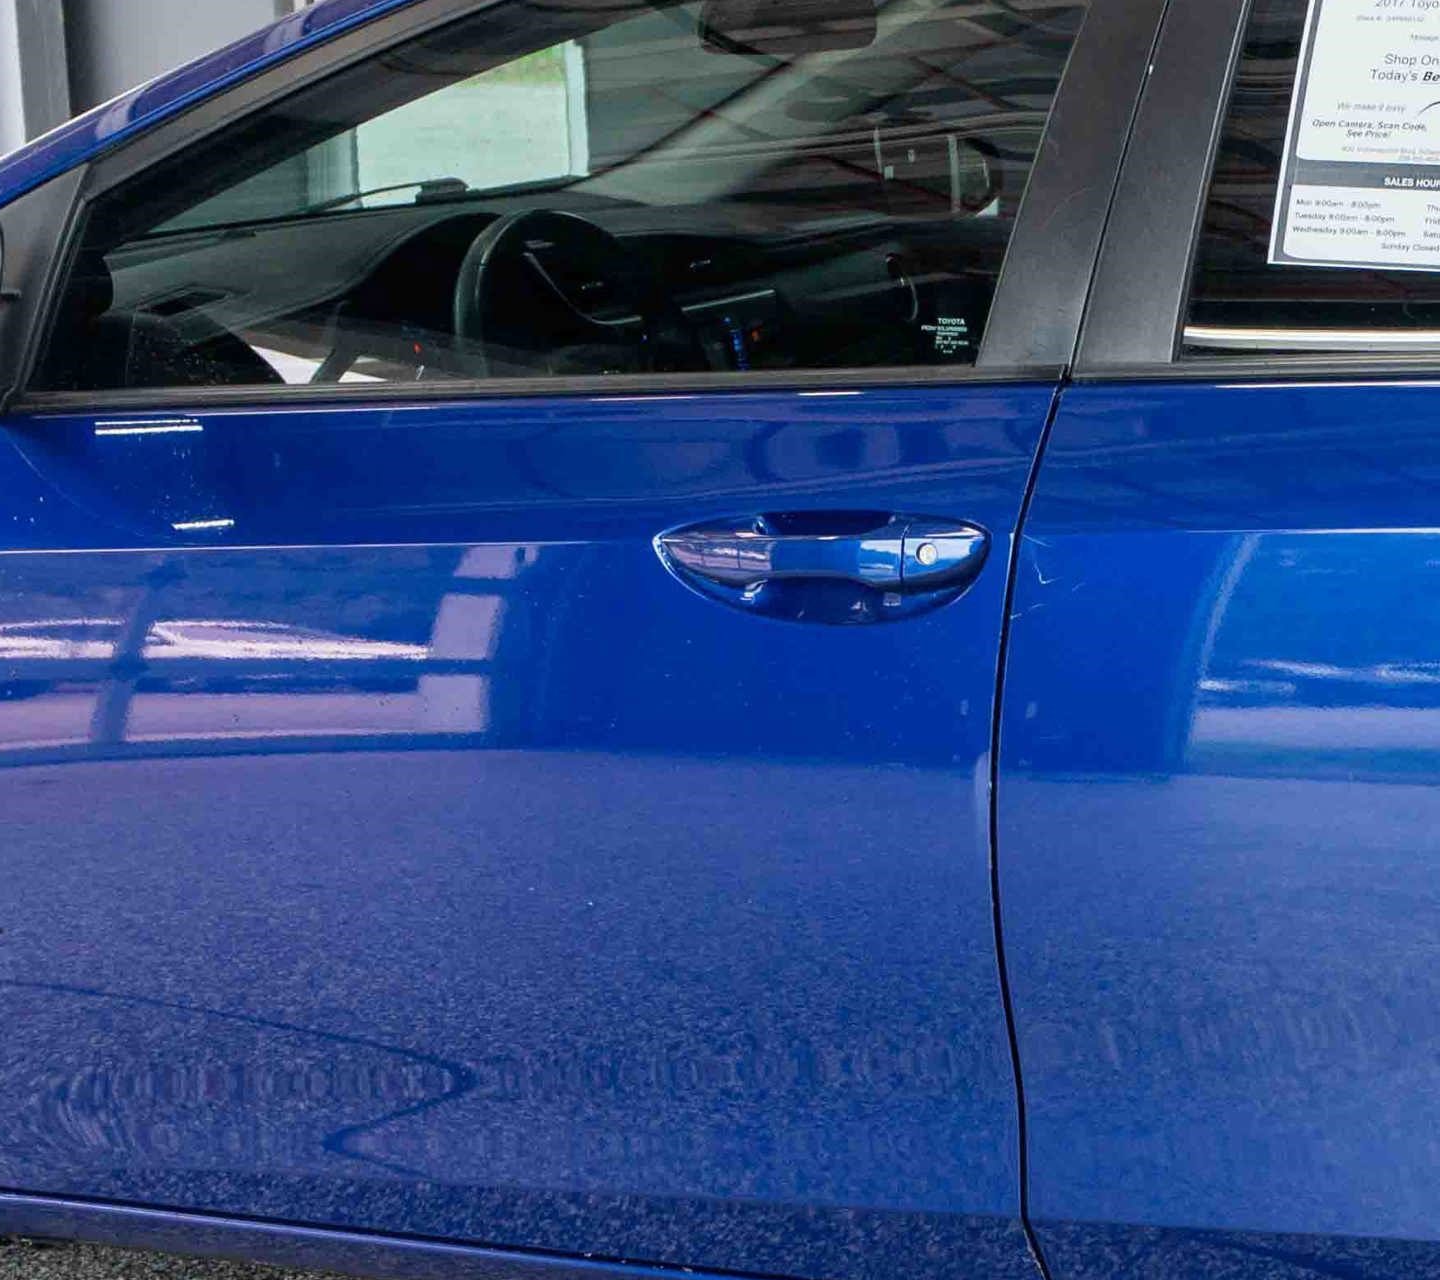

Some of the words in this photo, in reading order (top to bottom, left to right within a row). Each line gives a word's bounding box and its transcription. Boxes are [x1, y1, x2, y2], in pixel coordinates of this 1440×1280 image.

[1384, 53, 1418, 67] Shop
[1370, 69, 1419, 82] Today's
[1312, 119, 1336, 130] Open
[1377, 121, 1400, 130] Scan
[1384, 176, 1414, 187] SALES
[937, 317, 966, 325] TOYOTA
